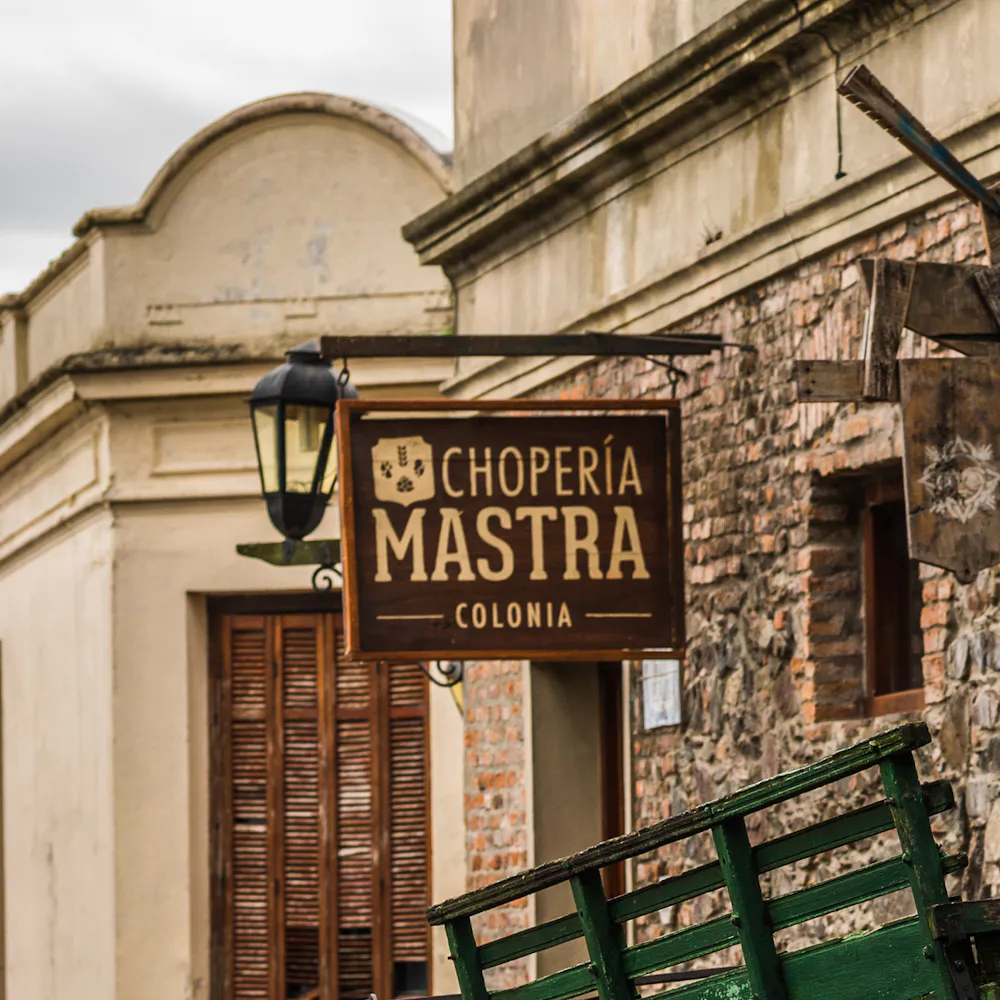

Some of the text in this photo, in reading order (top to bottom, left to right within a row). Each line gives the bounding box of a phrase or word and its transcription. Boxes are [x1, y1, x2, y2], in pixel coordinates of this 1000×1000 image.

[441, 434, 643, 498] CHOPERÍA
[371, 505, 651, 582] MASTRA
[455, 602, 573, 629] COLONIA
